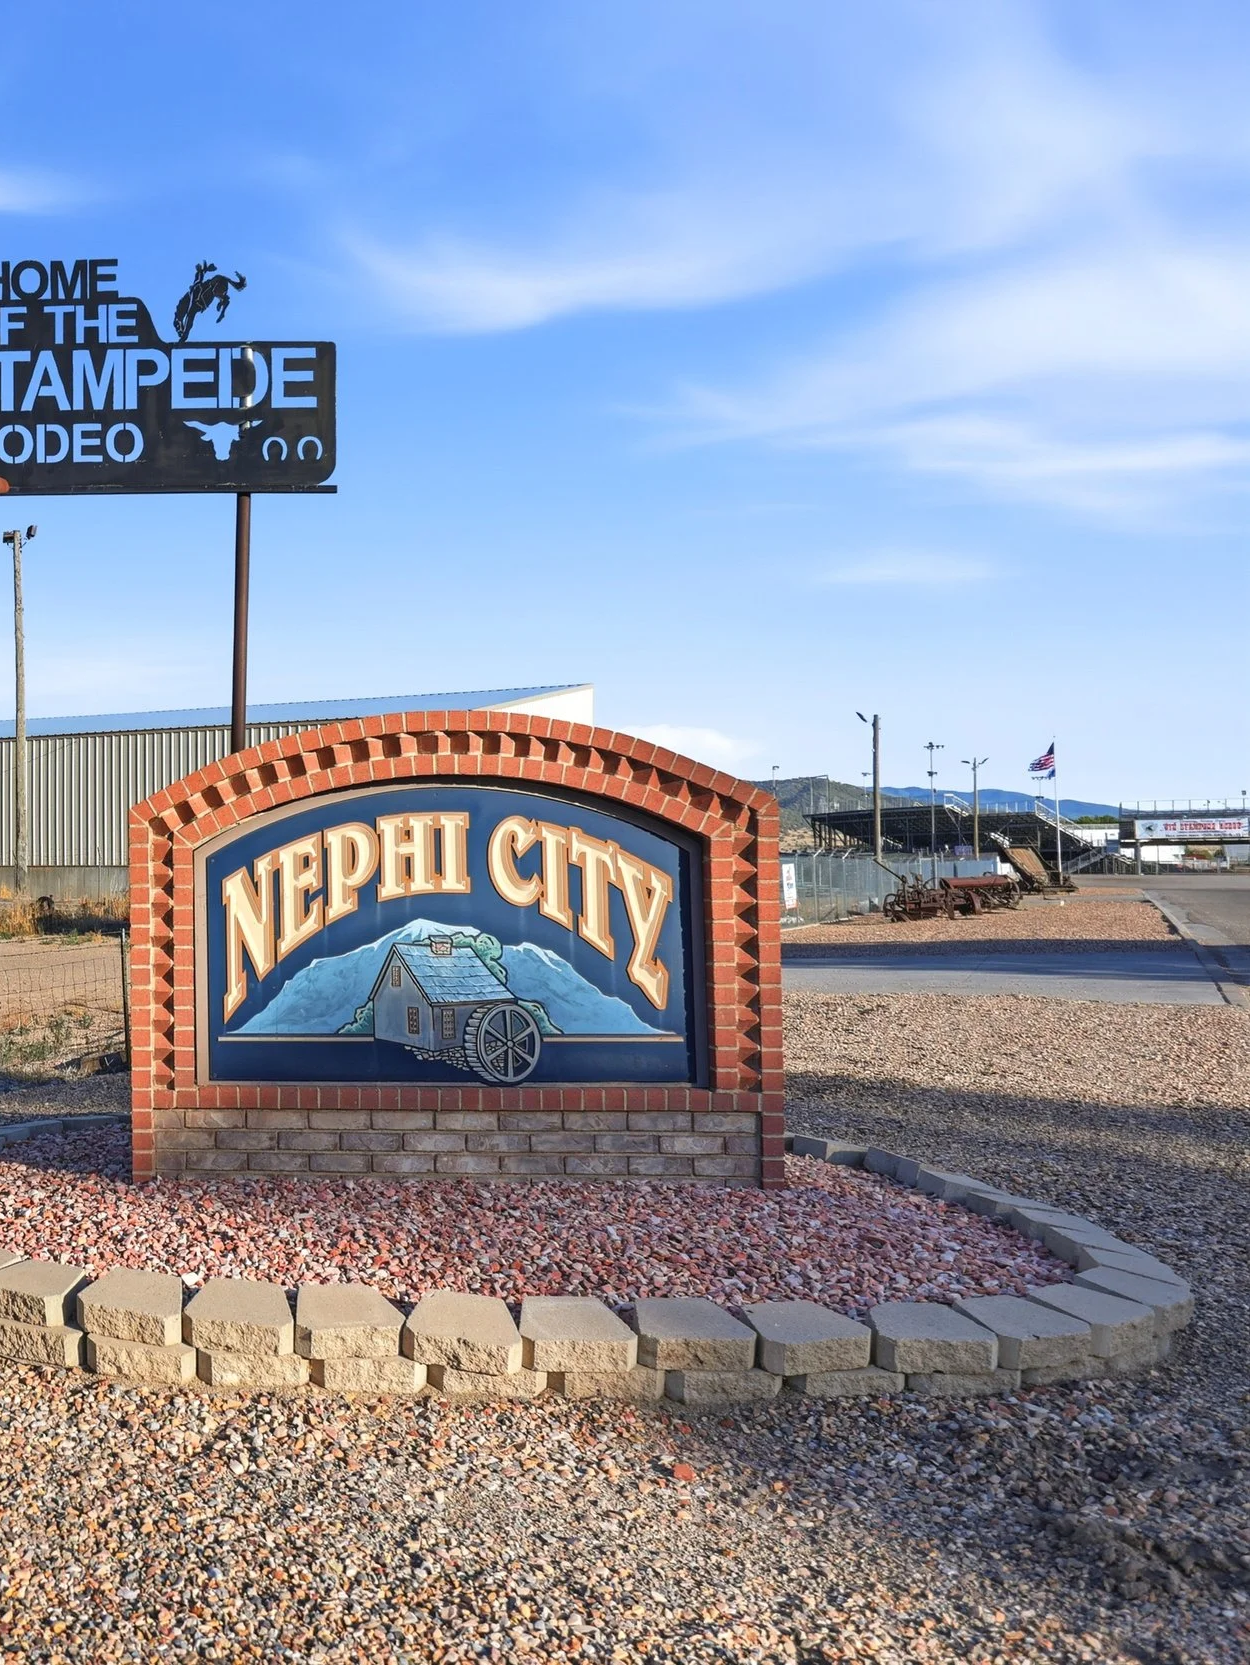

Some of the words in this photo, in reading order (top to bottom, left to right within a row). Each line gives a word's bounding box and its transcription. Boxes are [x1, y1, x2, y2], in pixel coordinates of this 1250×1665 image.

[44, 304, 139, 344] THE
[222, 811, 471, 1023] NEPHI
[488, 814, 673, 1011] CITY
